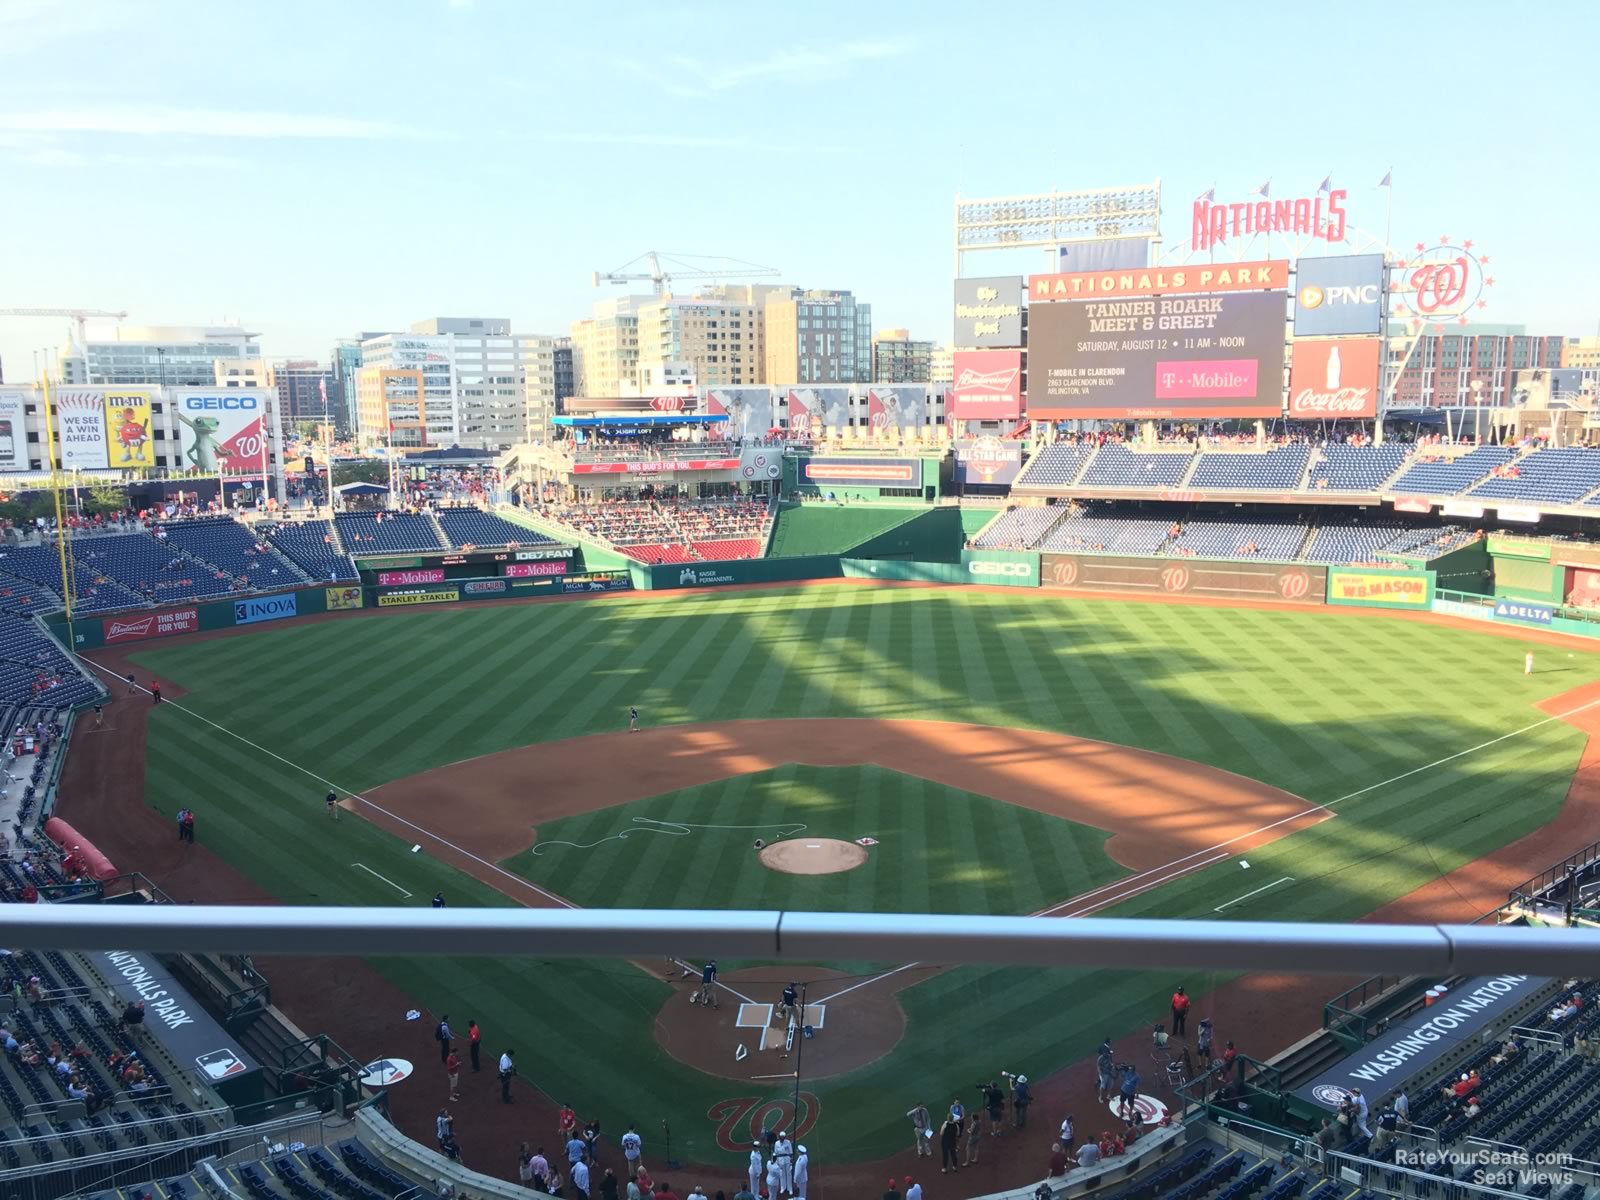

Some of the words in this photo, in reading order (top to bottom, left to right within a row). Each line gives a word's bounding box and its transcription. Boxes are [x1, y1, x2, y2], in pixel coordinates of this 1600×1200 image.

[1192, 189, 1347, 251] NATIONALS
[1036, 272, 1186, 295] NATIONALS
[1200, 267, 1272, 286] PARK
[1326, 285, 1378, 305] PNC
[1085, 301, 1155, 318] TANNER
[1160, 298, 1224, 315] ROARK
[1089, 317, 1138, 333] MEET
[1142, 316, 1154, 331] &
[1158, 314, 1217, 330] GREET
[1077, 340, 1119, 352] SATURDAY,
[1122, 340, 1154, 351] AUGUST
[1157, 339, 1168, 349] 12
[1184, 338, 1194, 349] 11
[1197, 338, 1211, 348] AM
[1219, 337, 1245, 348] NOON
[1047, 368, 1077, 377] T-MOBILE
[1079, 368, 1086, 376] IN
[1087, 368, 1125, 376] CLARENDON
[1063, 379, 1098, 387] CLARENDON
[186, 397, 257, 410] GEICO
[66, 434, 101, 442] AHEAD
[626, 463, 641, 471] THIS
[642, 462, 662, 471] BUD'S
[663, 462, 675, 470] FOR
[546, 549, 573, 559] FAN
[968, 561, 1031, 577] GEICO
[381, 594, 418, 605] STANLEY
[420, 592, 456, 602] STANLEY
[251, 599, 295, 616] INOVA
[1510, 607, 1549, 620] DELTA
[157, 615, 174, 624] THIS
[175, 611, 196, 621] BUD'S
[111, 622, 149, 635] Budweiser
[158, 624, 172, 633] FOR
[173, 620, 190, 631] YOU.
[151, 997, 195, 1031] PARK
[1349, 1008, 1467, 1082] WASHINGTON
